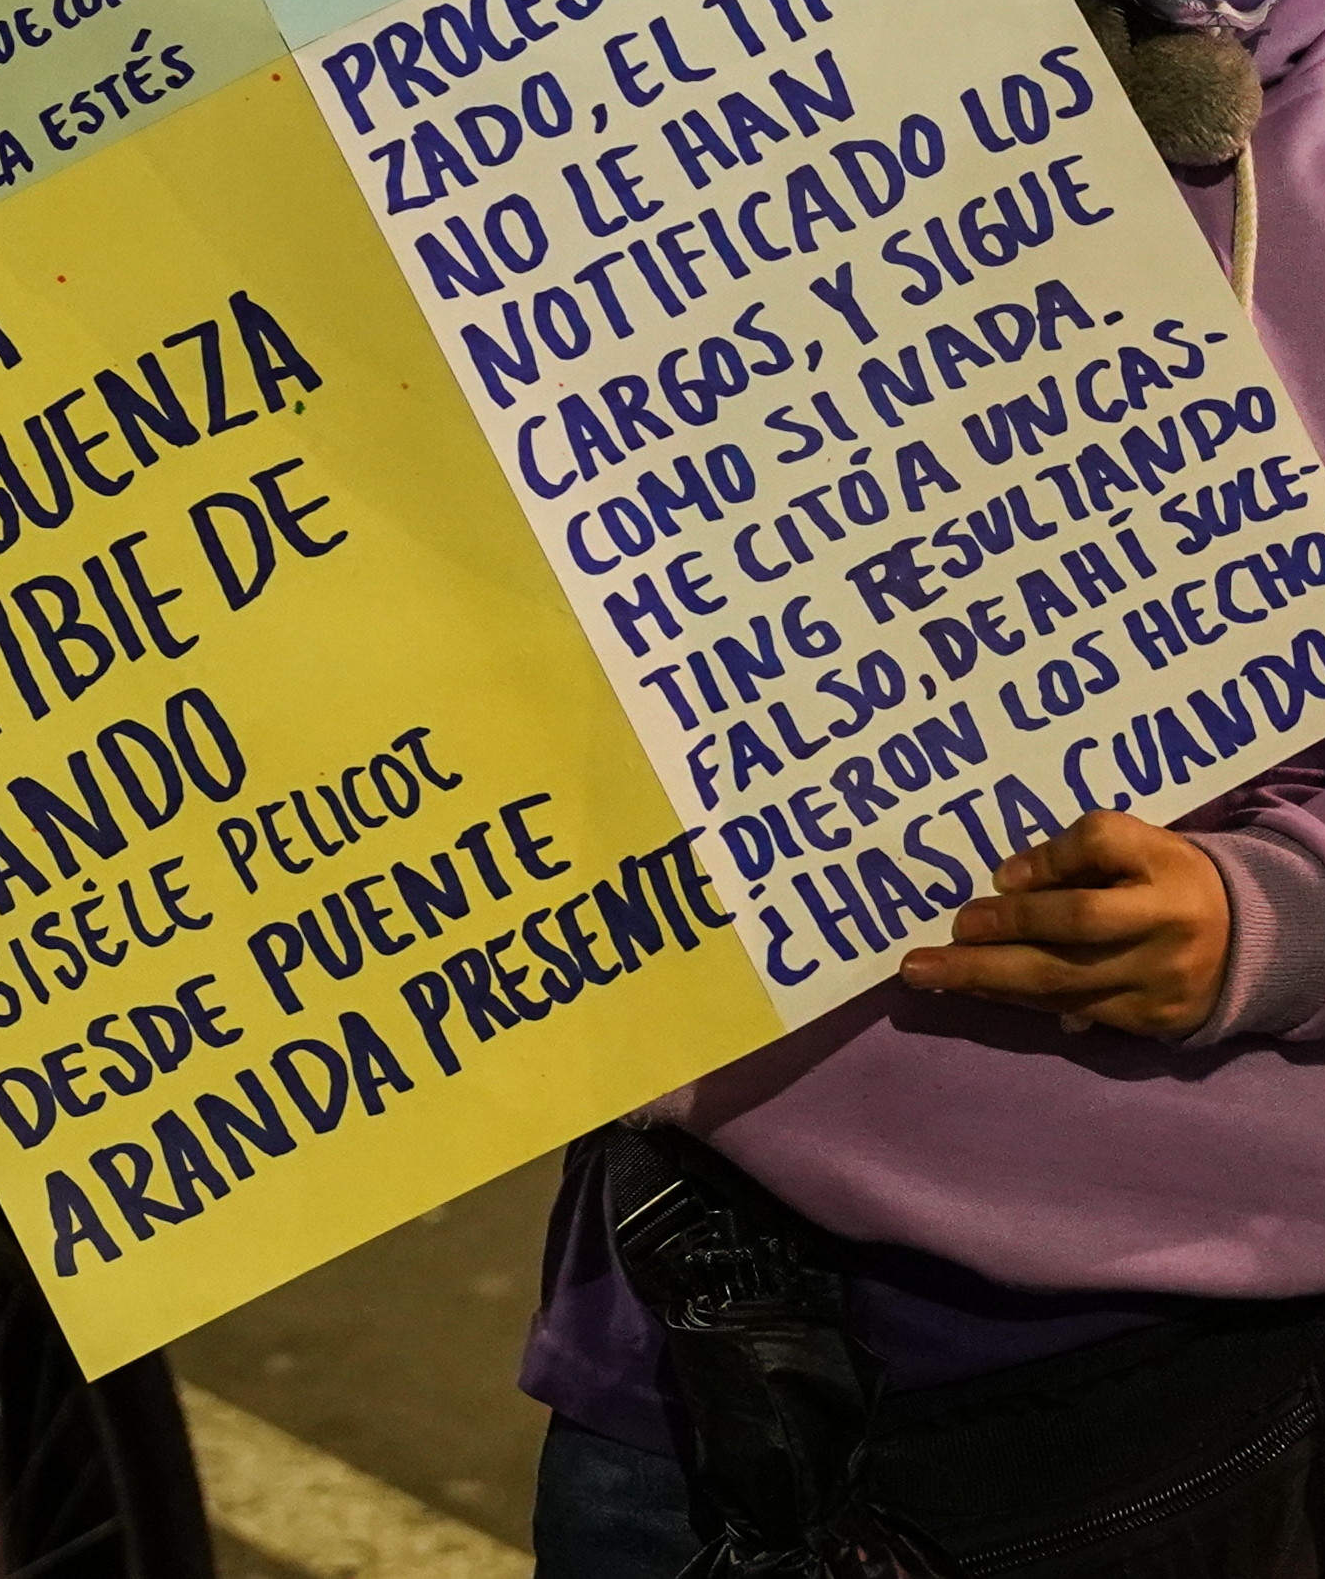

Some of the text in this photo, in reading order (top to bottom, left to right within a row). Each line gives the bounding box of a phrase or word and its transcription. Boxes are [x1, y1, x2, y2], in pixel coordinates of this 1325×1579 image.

[37, 27, 196, 152] ESTÉS
[366, 70, 609, 216] ZADO,
[601, 15, 718, 109] EL
[412, 48, 856, 301] NO LE HAN
[458, 45, 1095, 411] NOTIFICADO LOS
[515, 154, 1114, 501] CARGOS, Y SIGUE
[189, 459, 348, 610] DE
[564, 442, 758, 577] COMO
[762, 390, 860, 465] SI
[601, 549, 729, 659] ME
[731, 445, 890, 584] CITÓ
[893, 440, 960, 514] A
[959, 374, 1070, 467] UN
[637, 385, 1278, 732] TING RESULTANDO
[685, 648, 936, 812] FALSO,
[1015, 527, 1158, 637] AHÍ
[717, 700, 988, 883] DIERON
[997, 629, 1122, 733] LOS
[217, 726, 462, 893] PELICOT
[247, 793, 570, 1015] PUENTE
[45, 825, 737, 1278] ARANDA PRESENTE
